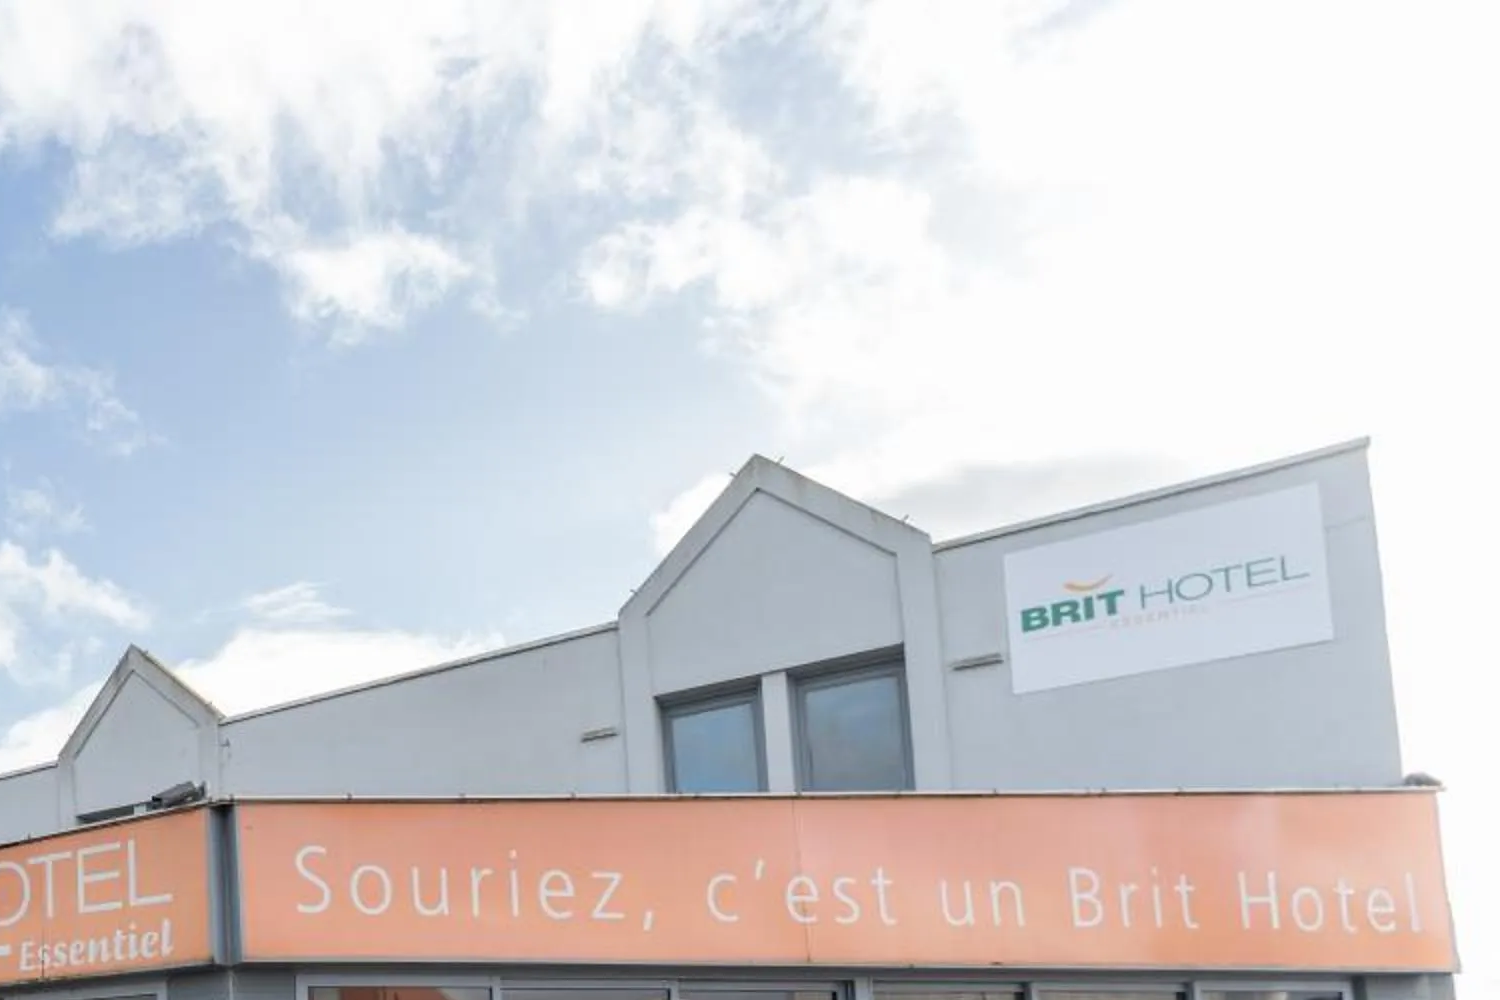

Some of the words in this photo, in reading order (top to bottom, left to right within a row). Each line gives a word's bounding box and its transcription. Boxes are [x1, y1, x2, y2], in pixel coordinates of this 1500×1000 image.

[1021, 588, 1125, 633] BRIT
[1139, 555, 1311, 609] HOTEL
[294, 845, 655, 931] Souriez,
[938, 878, 1026, 928] un
[1067, 866, 1199, 929] Brit
[1236, 871, 1422, 933] Hotel
[18, 920, 173, 972] Essentiel
